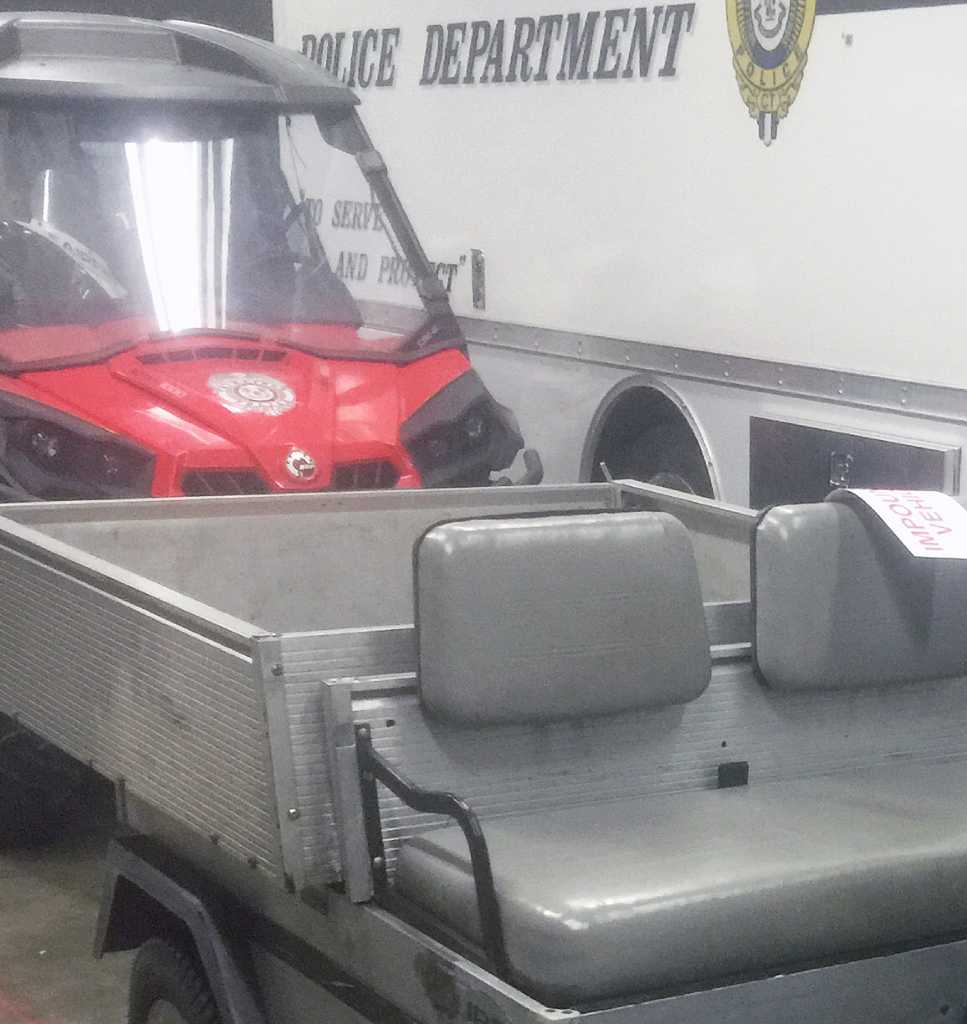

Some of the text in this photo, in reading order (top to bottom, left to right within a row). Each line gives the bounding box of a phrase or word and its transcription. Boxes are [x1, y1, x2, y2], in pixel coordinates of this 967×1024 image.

[419, 4, 695, 86] DEPARTMENT
[332, 200, 384, 232] SERVE
[336, 251, 368, 281] AND
[871, 488, 944, 551] IMPOU
[898, 490, 952, 534] VEHI
